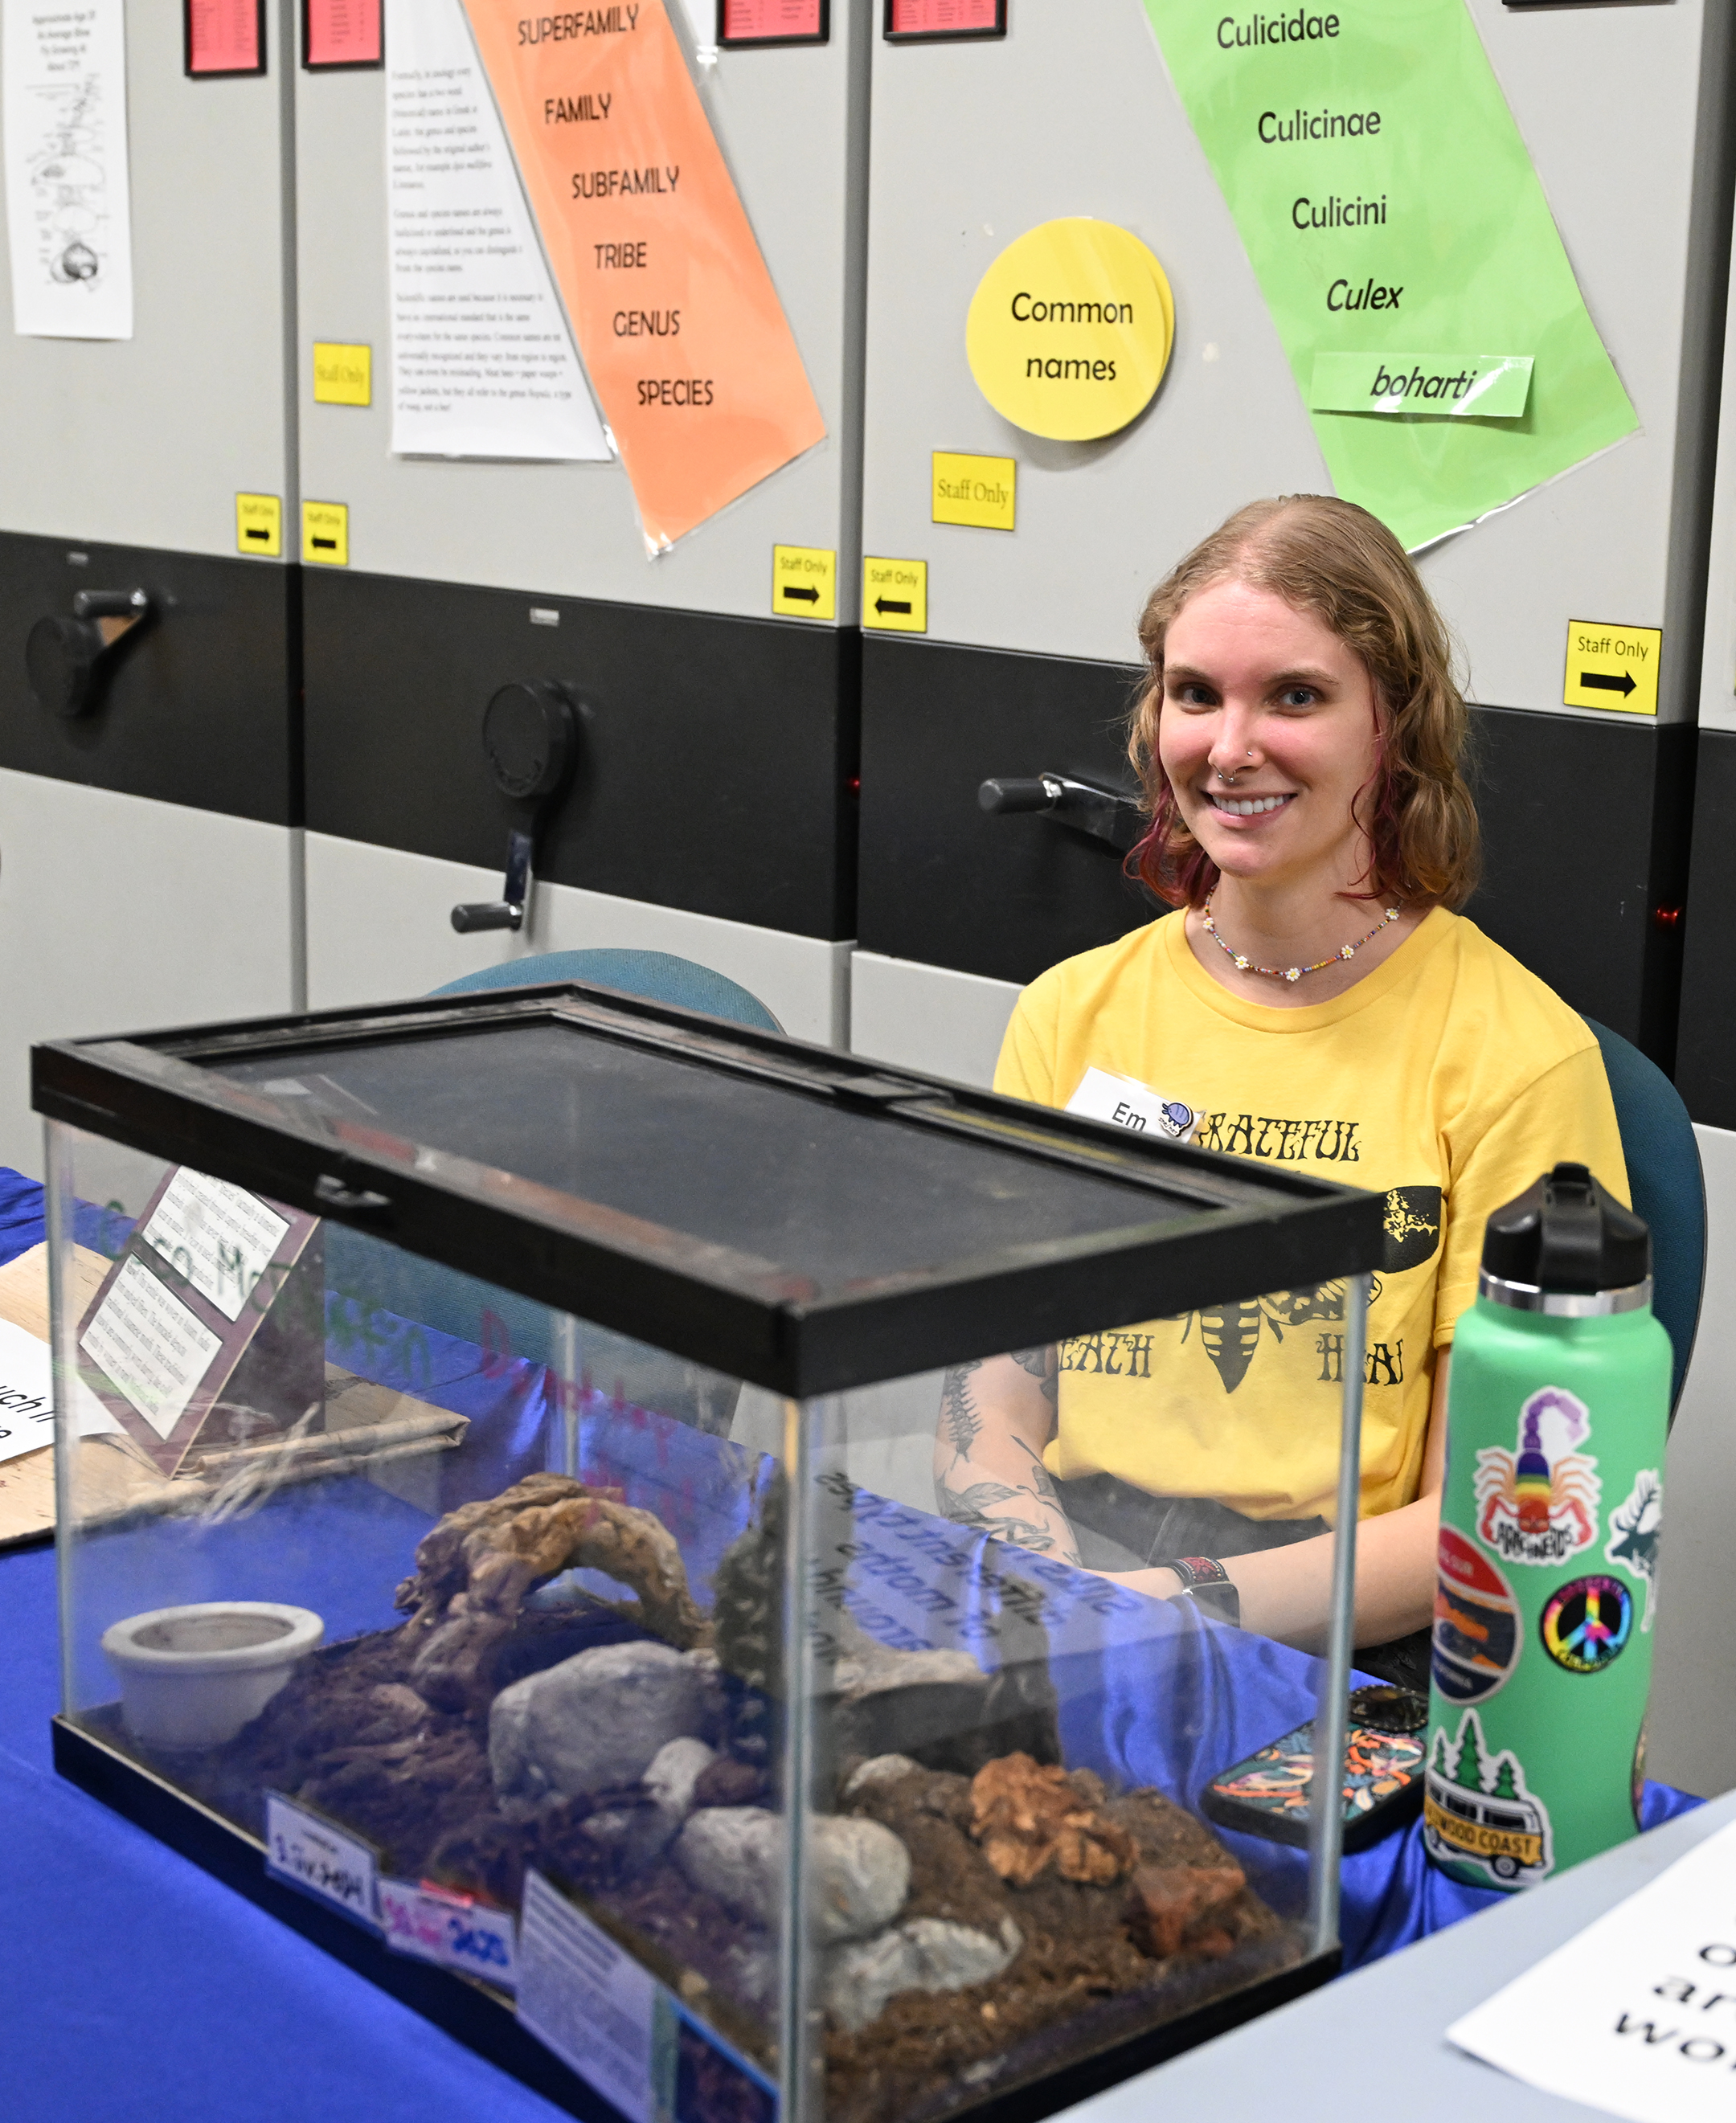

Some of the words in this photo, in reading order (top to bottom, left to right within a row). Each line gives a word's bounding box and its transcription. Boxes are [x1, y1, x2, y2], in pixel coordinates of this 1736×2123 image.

[518, 2, 640, 46] SUPERFAMILY
[1216, 10, 1341, 49] Culicidae
[544, 92, 612, 125] FAMILY
[1257, 108, 1382, 144] Culicinae
[571, 166, 680, 200] SUBFAMILY
[1292, 194, 1388, 230] Culicini
[594, 242, 648, 268] TRIBE
[1011, 292, 1133, 324] Common
[1326, 278, 1404, 312] Culex
[612, 310, 681, 337] GENUS
[1026, 358, 1116, 381] names
[1370, 365, 1477, 399] boharti
[637, 379, 714, 406] SPECIES
[937, 478, 971, 501] Staff
[974, 482, 1009, 509] Only
[780, 557, 802, 571] Staff
[804, 559, 827, 576] Only
[870, 569, 893, 584] Staff
[895, 571, 918, 588] Only
[1578, 636, 1611, 654] Staff
[1615, 640, 1648, 662] Only
[1112, 1102, 1147, 1131] Em
[1194, 1112, 1362, 1162] RATEFUL
[1058, 1332, 1156, 1379] EATH
[1478, 1830, 1531, 1855] COAST
[1614, 2011, 1736, 2072] wo
